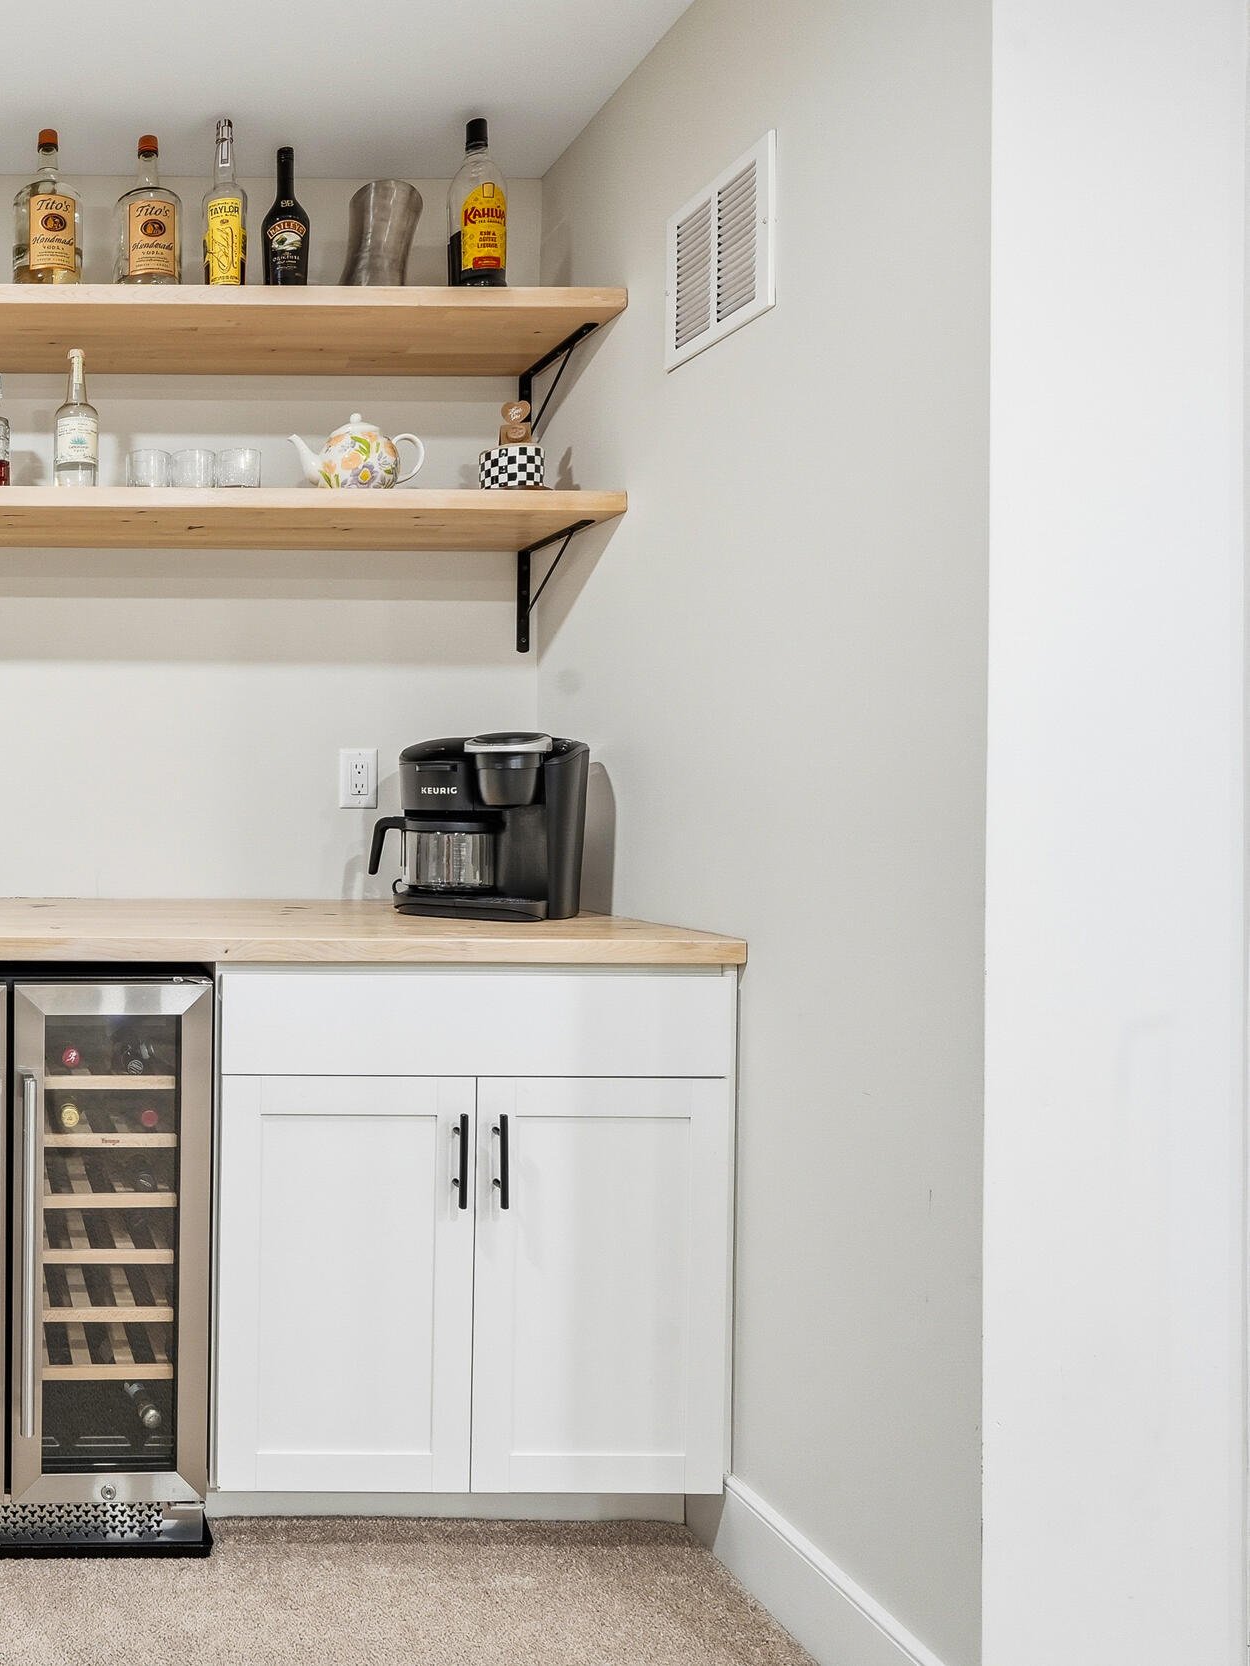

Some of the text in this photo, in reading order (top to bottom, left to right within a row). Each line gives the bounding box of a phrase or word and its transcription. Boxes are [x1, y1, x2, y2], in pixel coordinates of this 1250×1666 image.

[36, 198, 70, 212] Tito's
[135, 204, 170, 217] Tito's
[210, 206, 240, 217] TAYLOR
[421, 786, 458, 795] KEURIG
